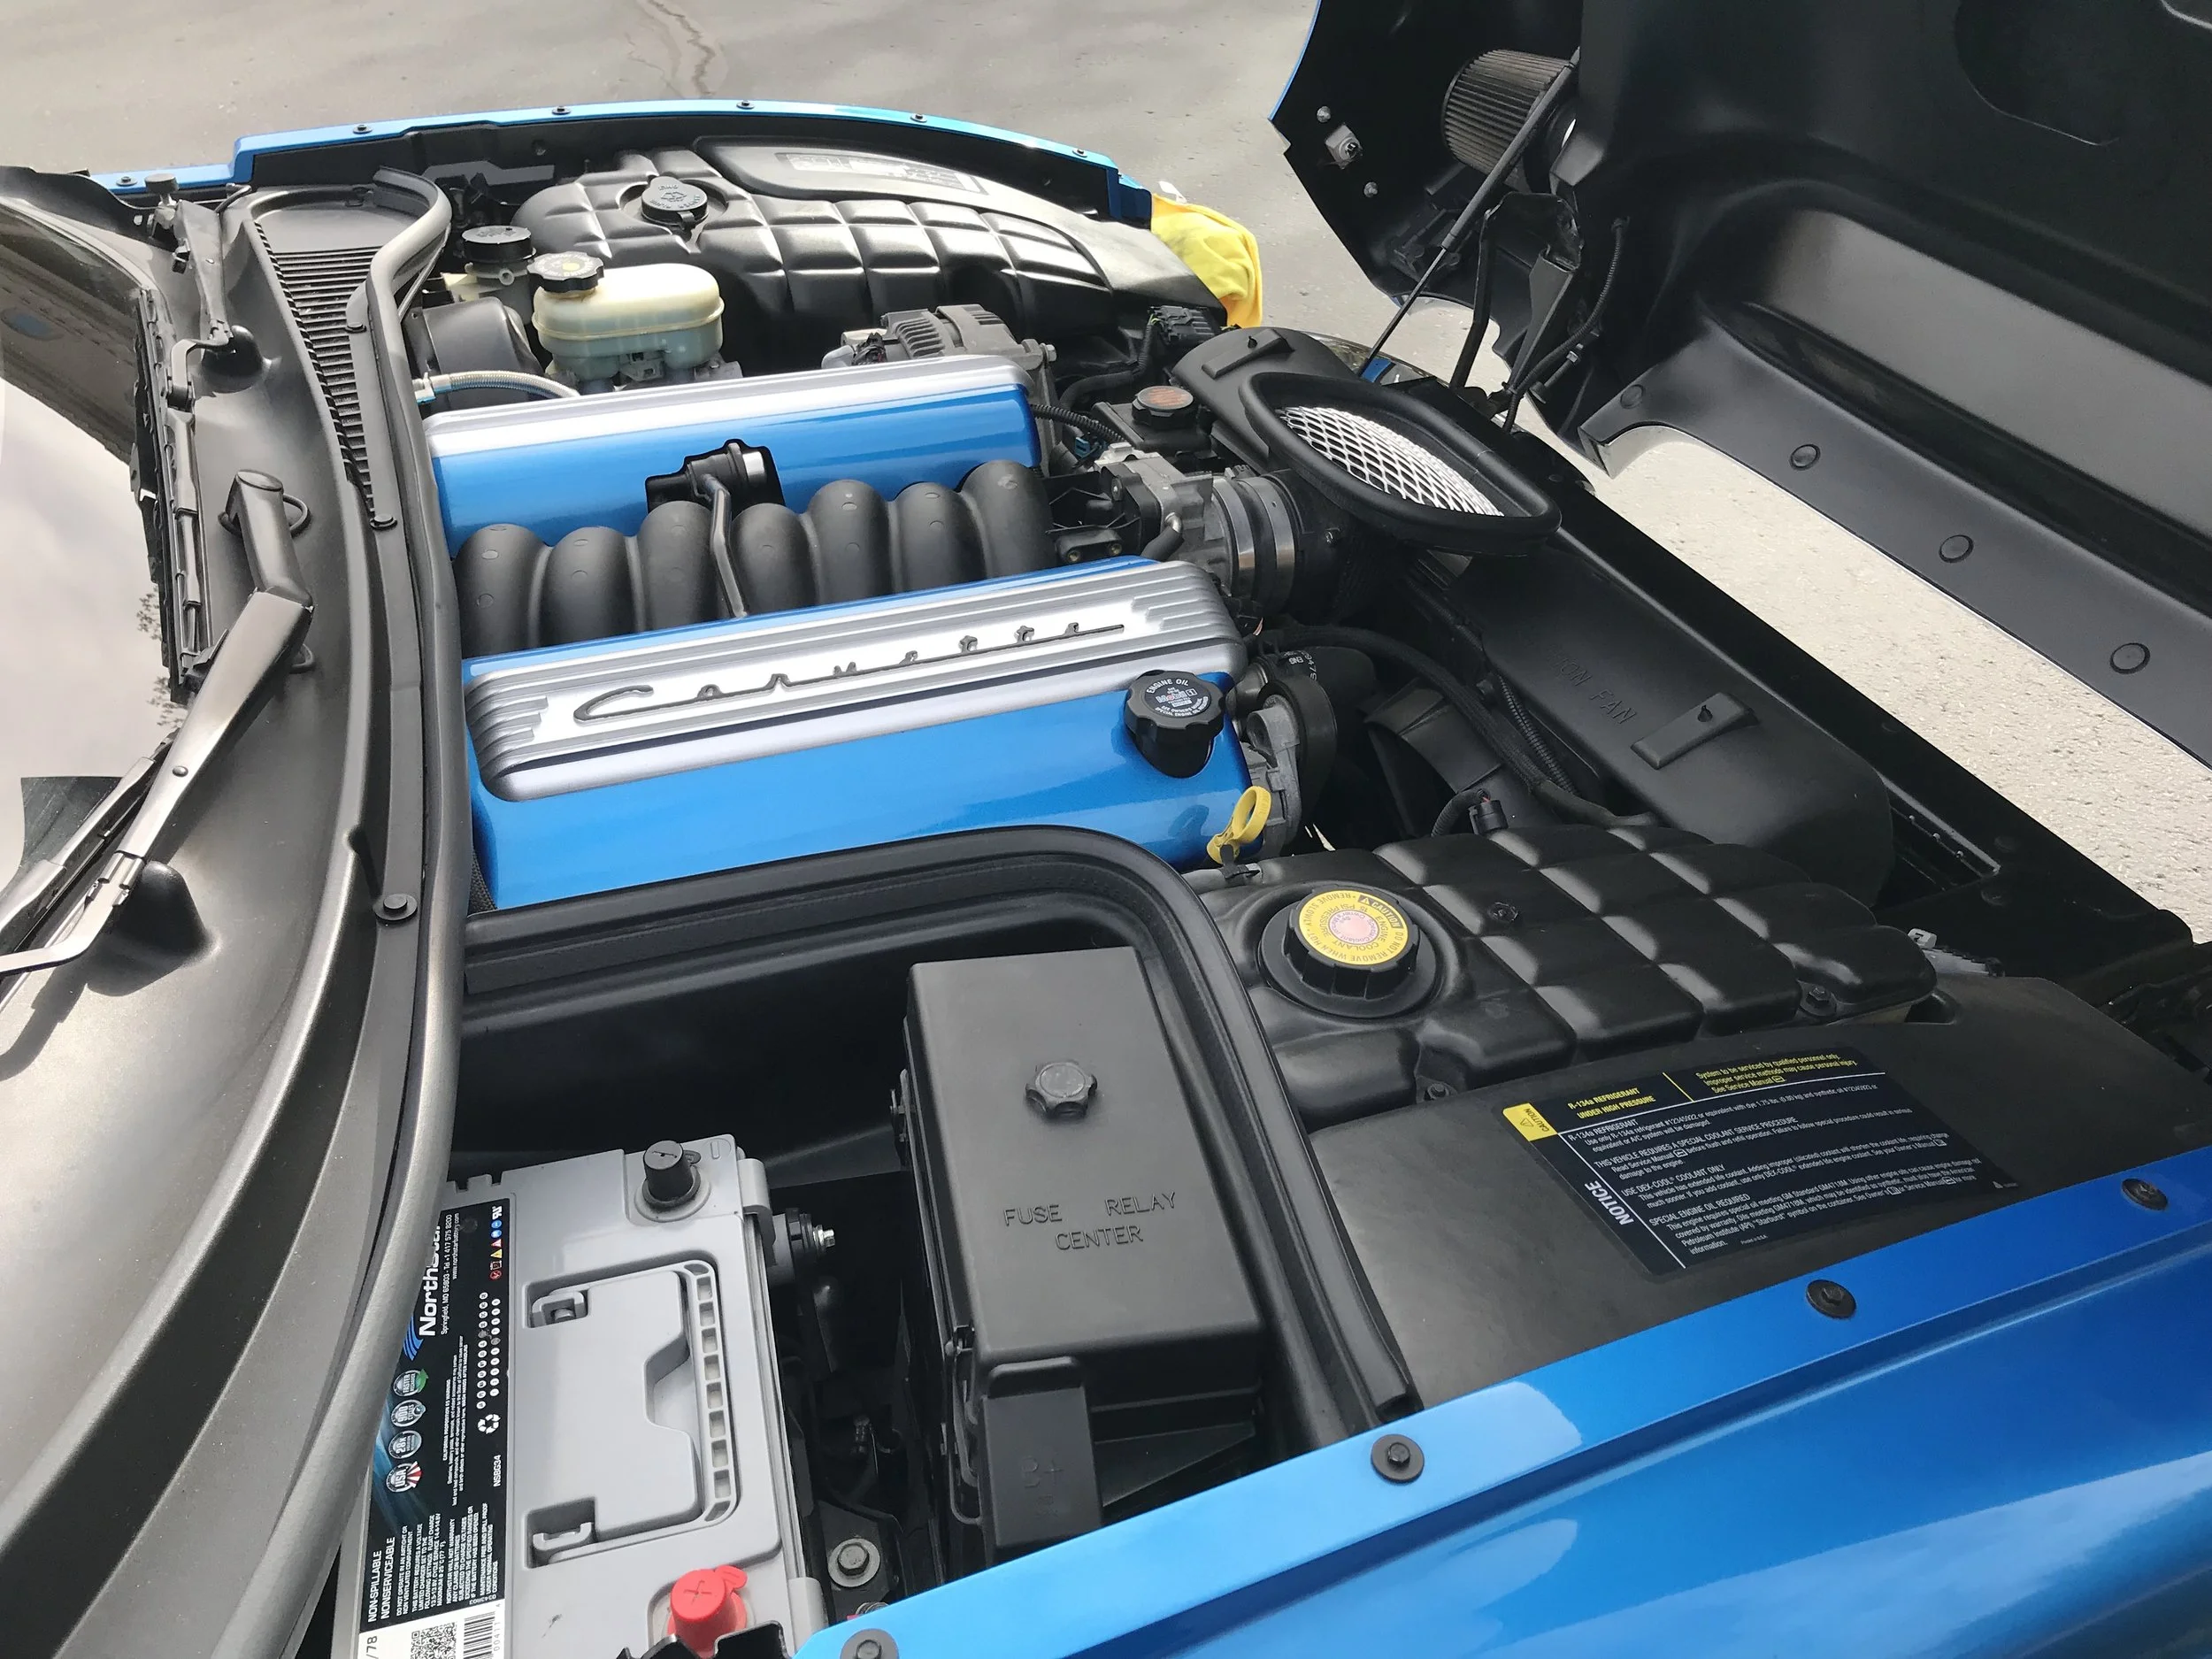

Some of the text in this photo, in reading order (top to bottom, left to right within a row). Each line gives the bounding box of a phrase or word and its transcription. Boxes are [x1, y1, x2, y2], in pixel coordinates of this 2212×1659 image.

[1146, 679, 1173, 694] ENGINE
[1589, 689, 1638, 724] FAN
[1317, 893, 1351, 905] REMOVE
[1302, 902, 1320, 926] SLOWLY
[1320, 904, 1341, 938] PRESSURE
[1371, 902, 1402, 929] CAUTION
[1333, 915, 1388, 952] ENGINE COOLANT
[1308, 932, 1403, 962] DO NOT REMOVE WHEN HOT
[1695, 1070, 1723, 1079] System
[1724, 1081, 1750, 1090] Service
[1567, 1087, 1640, 1109] R-134a REFRIGERANT
[1576, 1108, 1602, 1118] UNDER
[1618, 1095, 1655, 1108] PRESSURE
[1525, 1108, 1548, 1132] CAUTION
[1567, 1119, 1640, 1141] R-134a REFRIGERANT
[1609, 1129, 1634, 1138] R-134a
[1633, 1121, 1666, 1133] refrigerant
[1609, 1152, 1640, 1164] VEHICLE
[1638, 1144, 1673, 1156] REQUIRES
[1677, 1136, 1705, 1147] SPECIAL
[1703, 1129, 1735, 1140] COOLANT
[1733, 1124, 1762, 1133] SERVICE
[1759, 1117, 1798, 1128] PROCEDURE
[1641, 1130, 1664, 1140] system
[1627, 1158, 1653, 1168] Service
[1651, 1152, 1675, 1163] Manual
[1686, 1144, 1706, 1153] before
[1617, 1169, 1646, 1180] damage
[1652, 1187, 1677, 1196] vehicle
[1686, 1177, 1716, 1187] extended
[1675, 1169, 1709, 1181] COOLANT
[1003, 1191, 1176, 1226] FUSE RELAY
[1585, 1180, 1633, 1225] NOTICE
[1648, 1212, 1680, 1225] SPECIAL
[1678, 1205, 1705, 1217] ENGINE
[1716, 1194, 1751, 1207] REQUIRED
[1680, 1217, 1705, 1227] engine
[1702, 1210, 1730, 1221] requires
[1727, 1203, 1751, 1214] special
[1757, 1196, 1784, 1206] meeting
[1791, 1187, 1819, 1196] Standard
[1674, 1227, 1701, 1238] covered
[1747, 1207, 1776, 1218] meeting
[1681, 1207, 1810, 1246] Petroleum Institute symbol
[1055, 1225, 1144, 1250] CENTER
[419, 1226, 440, 1336] North
[442, 1294, 449, 1303] MO
[397, 1406, 408, 1422] 900
[396, 1470, 406, 1486] USA
[368, 1551, 381, 1622] NON-SPILLABLE
[381, 1537, 395, 1619] NONSERVICEABLE
